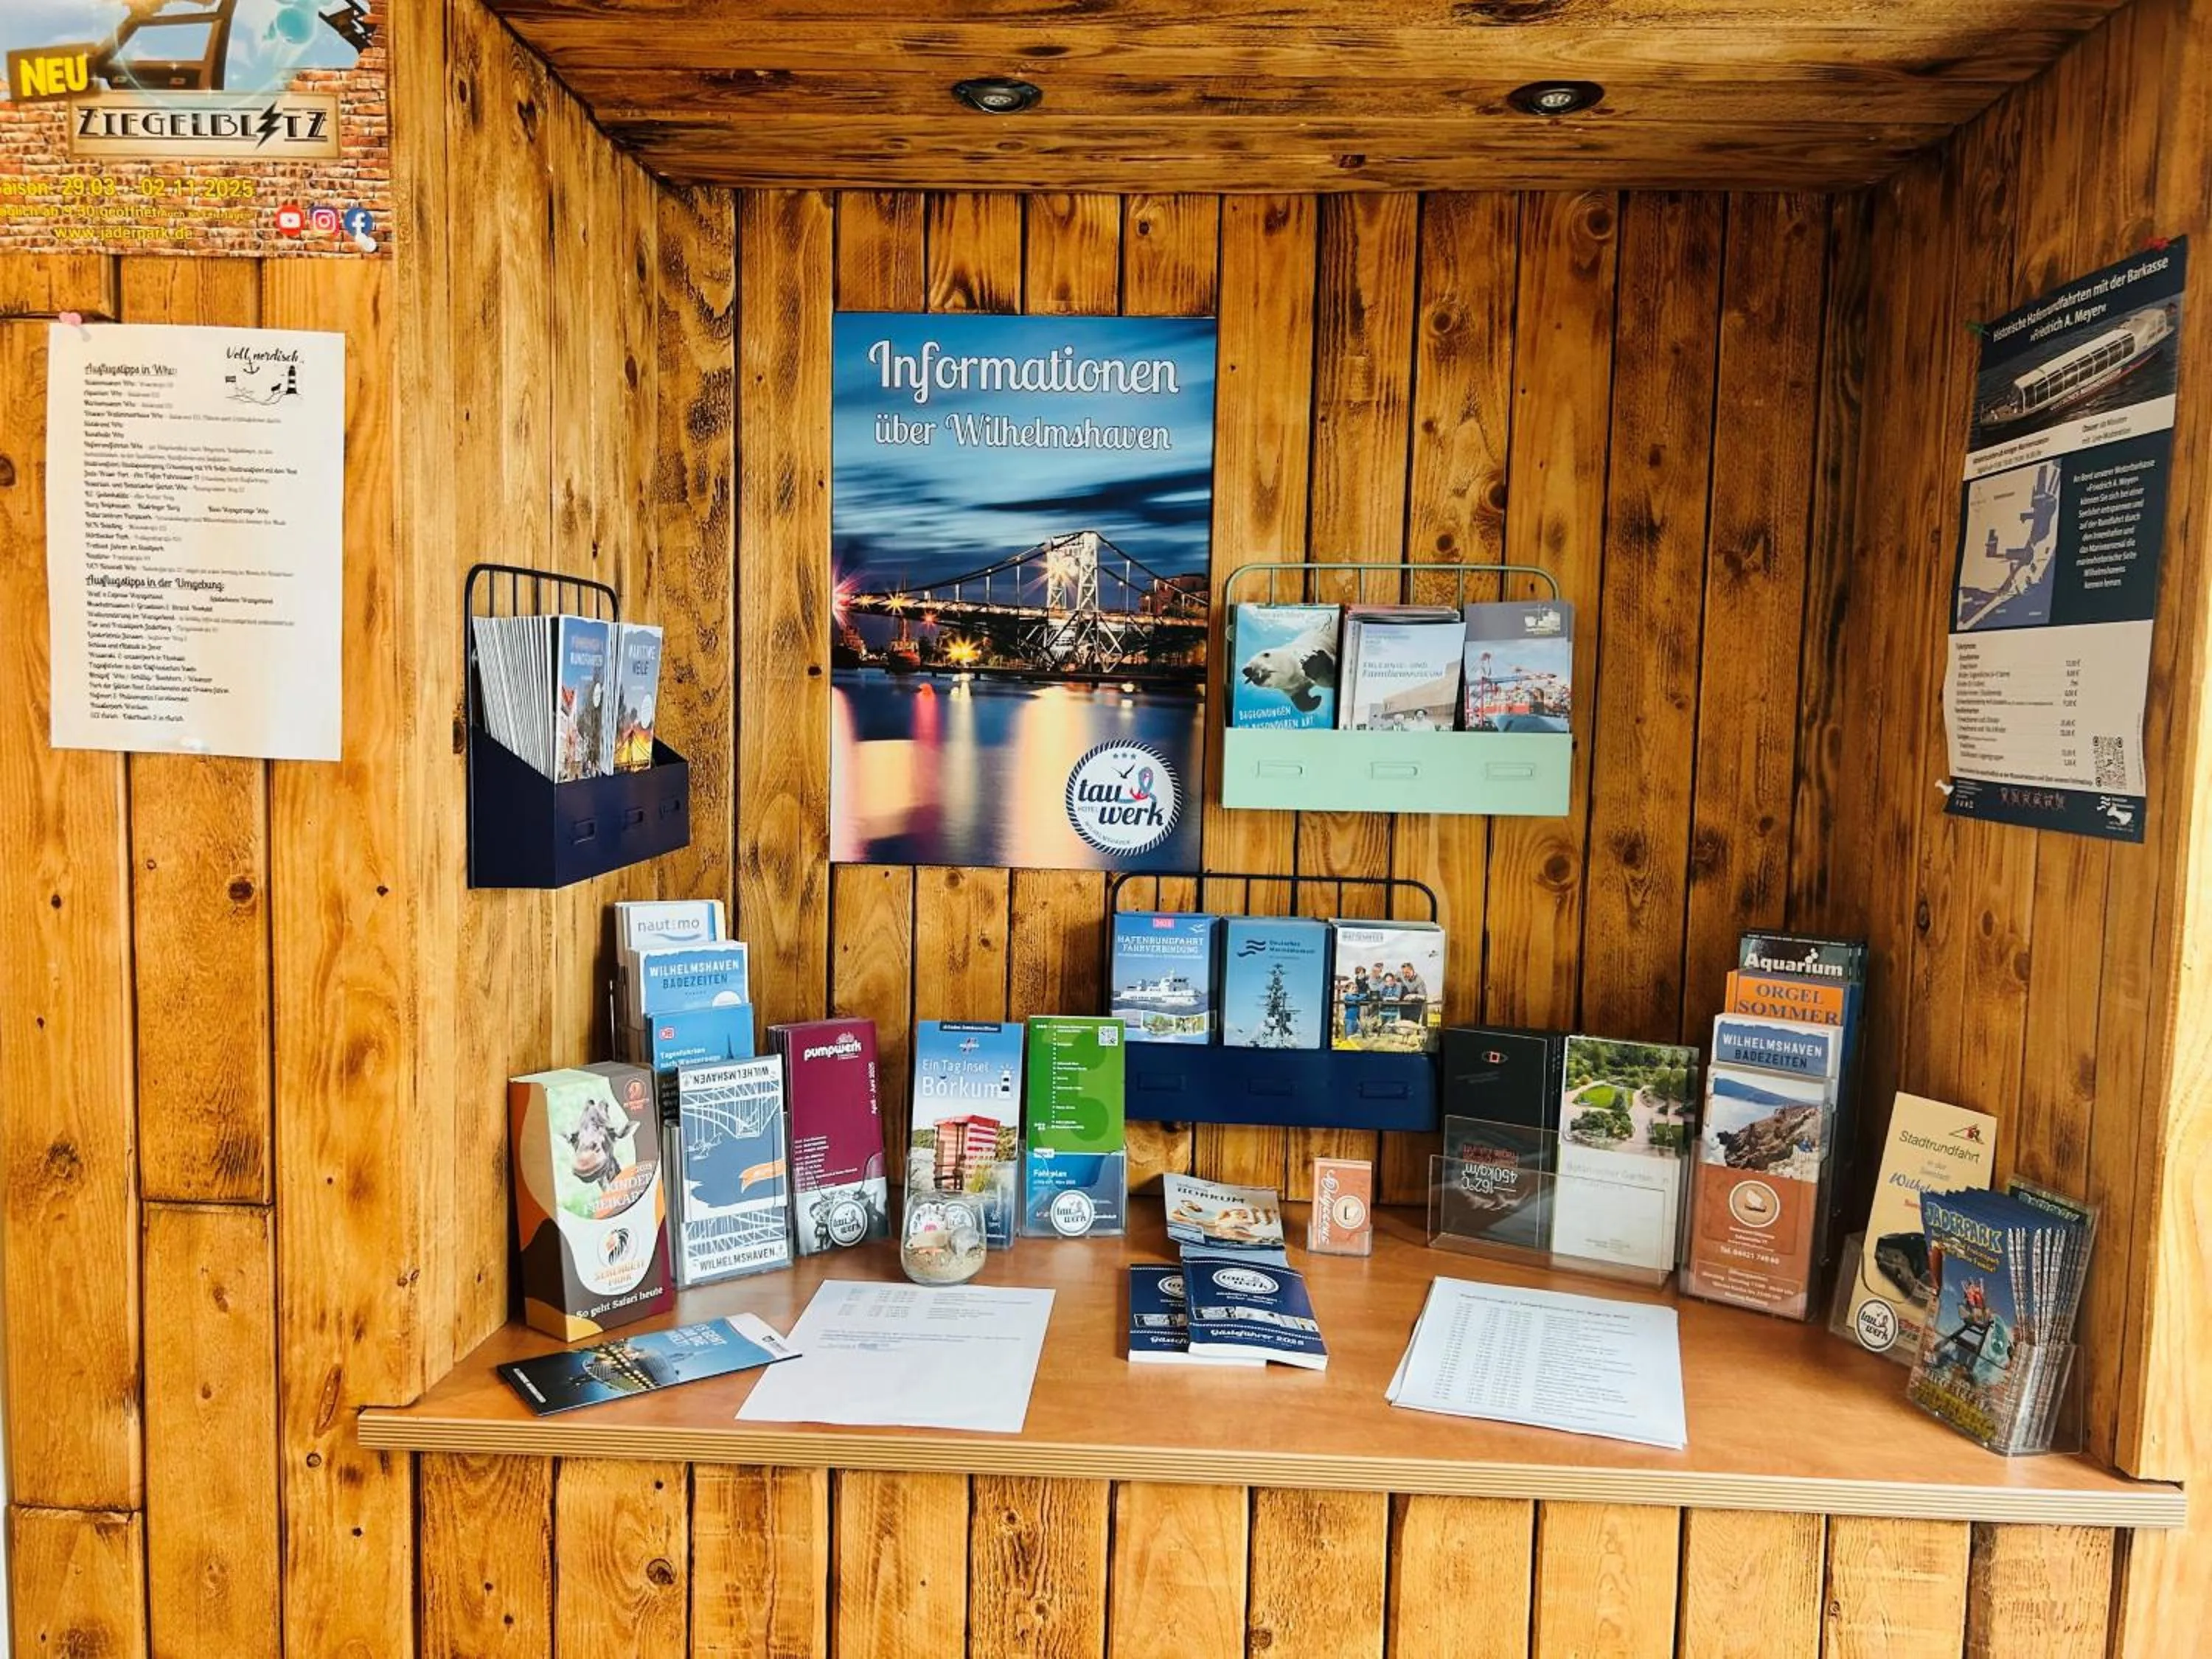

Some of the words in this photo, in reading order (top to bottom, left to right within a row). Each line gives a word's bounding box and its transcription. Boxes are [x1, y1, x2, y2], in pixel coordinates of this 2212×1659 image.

[19, 55, 88, 97] NEU
[2092, 279, 2110, 298] mit
[2110, 272, 2127, 292] der
[2126, 256, 2170, 285] Barkasse
[867, 339, 1180, 404] Informationen
[874, 413, 937, 445] über
[945, 411, 1172, 451] Wilhelmshaven
[86, 574, 145, 588] Ausflugstipps
[158, 577, 173, 588] der
[174, 577, 226, 592] Umgebung:
[1077, 779, 1123, 803] tau
[1098, 800, 1165, 827] werk
[1117, 935, 1204, 946] HAFENRUNDFAHRT
[649, 959, 740, 977] WILHELMSHAVEN
[1743, 951, 1843, 977] Aquarium
[663, 973, 729, 989] BADEZEITEN
[1756, 984, 1824, 1005] ORGEL
[1737, 999, 1838, 1026] SOMMER
[804, 1040, 863, 1061] pumpwerk
[1722, 1032, 1823, 1057] WILHELMSHAVEN
[922, 1058, 939, 1071] Ein
[941, 1059, 961, 1074] Tag
[1734, 1048, 1807, 1068] BADEZEITEN
[692, 1067, 770, 1085] WILHELMSHAVEN
[922, 1075, 1001, 1098] Borkum
[1899, 1130, 1980, 1164] Stadtrundfahrt
[1924, 1201, 2003, 1253] JADERPARK
[700, 1248, 776, 1271] WILHELMSHAVEN
[576, 1310, 589, 1318] So
[590, 1302, 611, 1318] geht
[611, 1293, 639, 1310] Safari
[639, 1286, 664, 1301] heute
